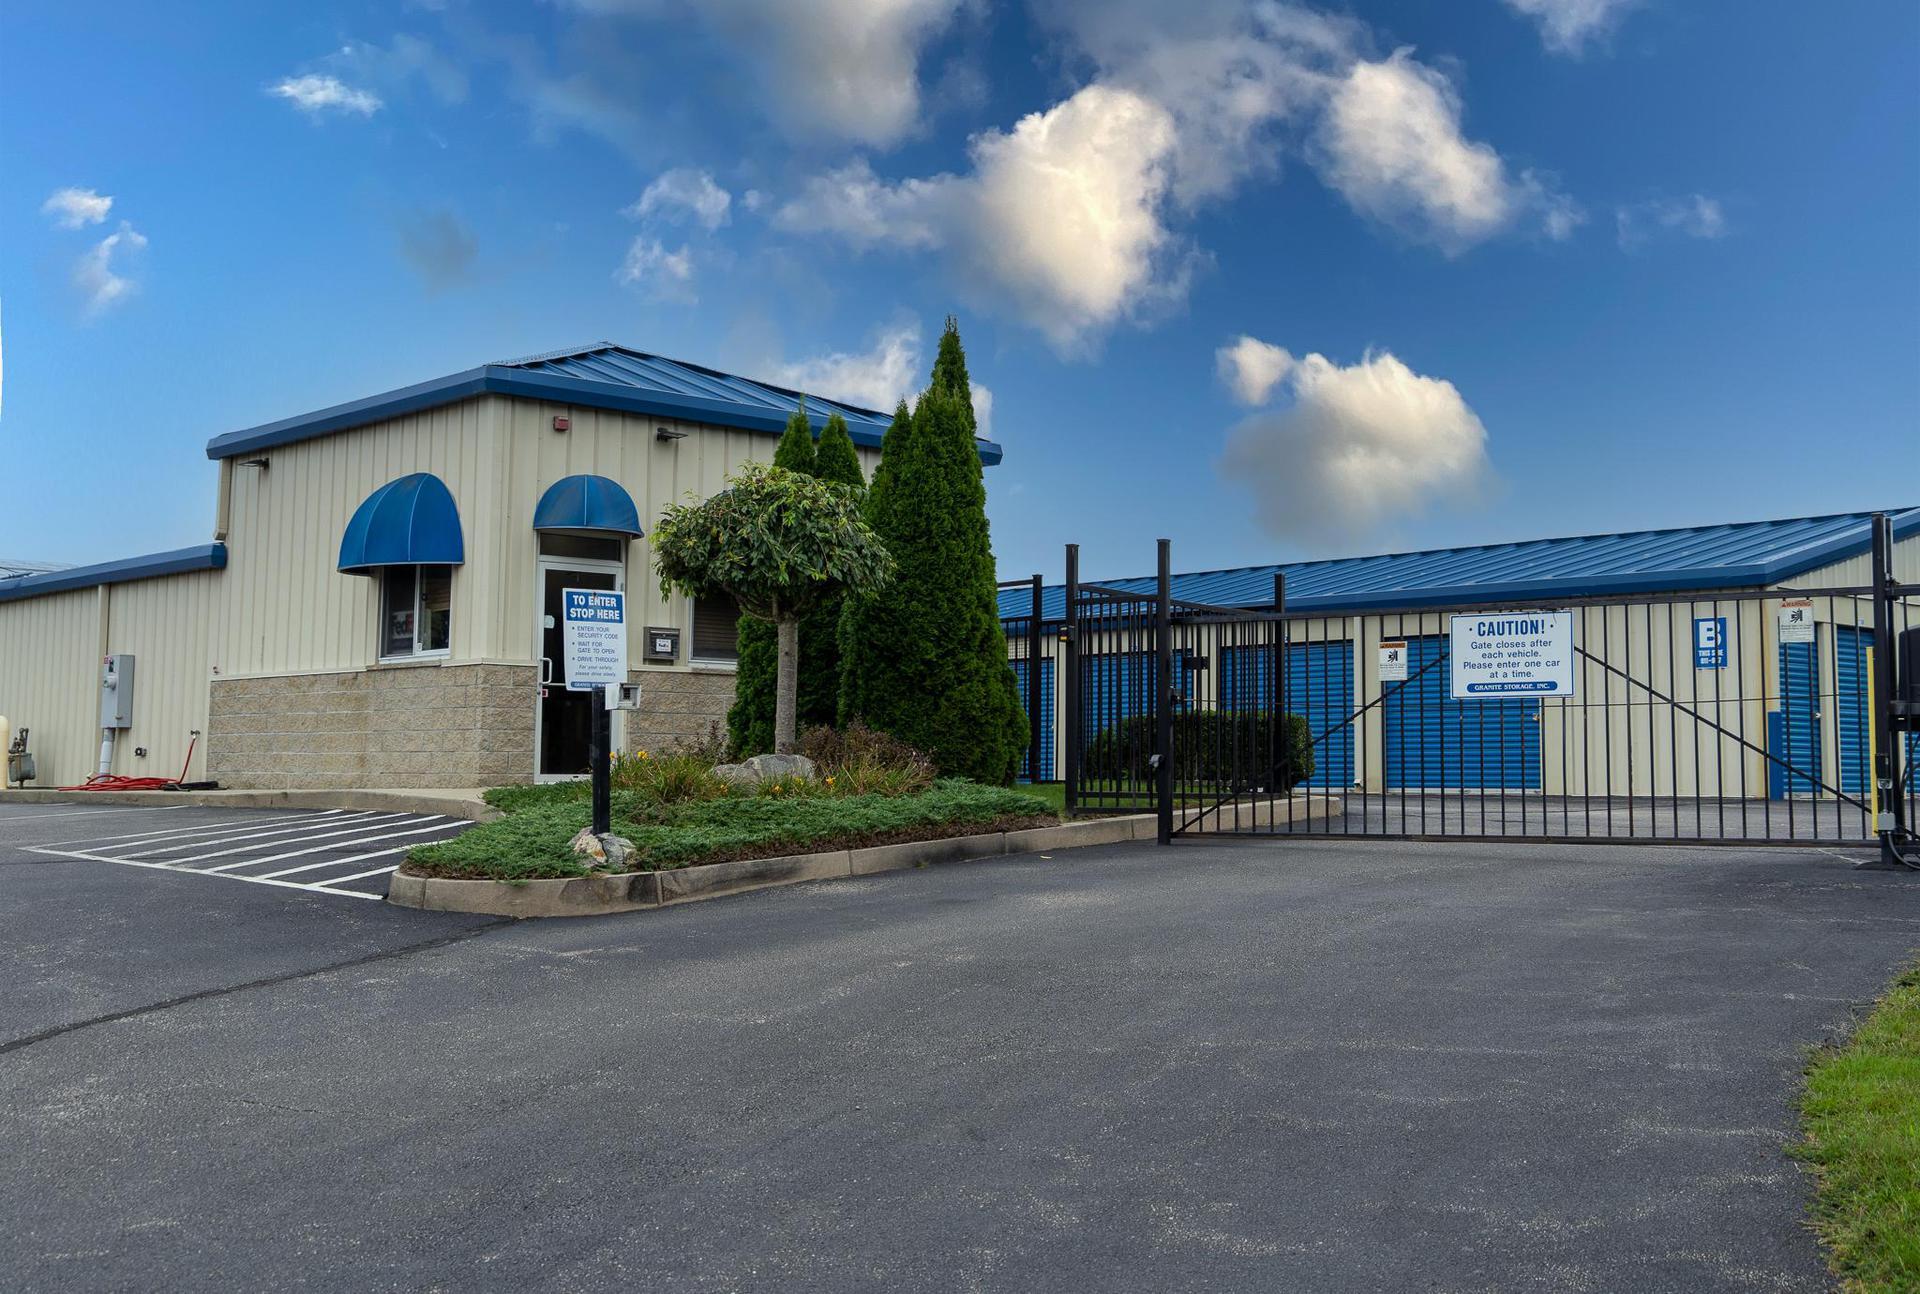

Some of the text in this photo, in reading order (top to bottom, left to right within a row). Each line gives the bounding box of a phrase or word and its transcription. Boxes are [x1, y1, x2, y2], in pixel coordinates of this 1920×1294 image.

[573, 595, 616, 607] TO ENTER
[570, 608, 620, 620] STOP HERE
[1478, 620, 1545, 636] CAUTION!
[1699, 621, 1721, 648] B
[1471, 639, 1552, 650] Gate closes after
[1464, 661, 1492, 669] Please
